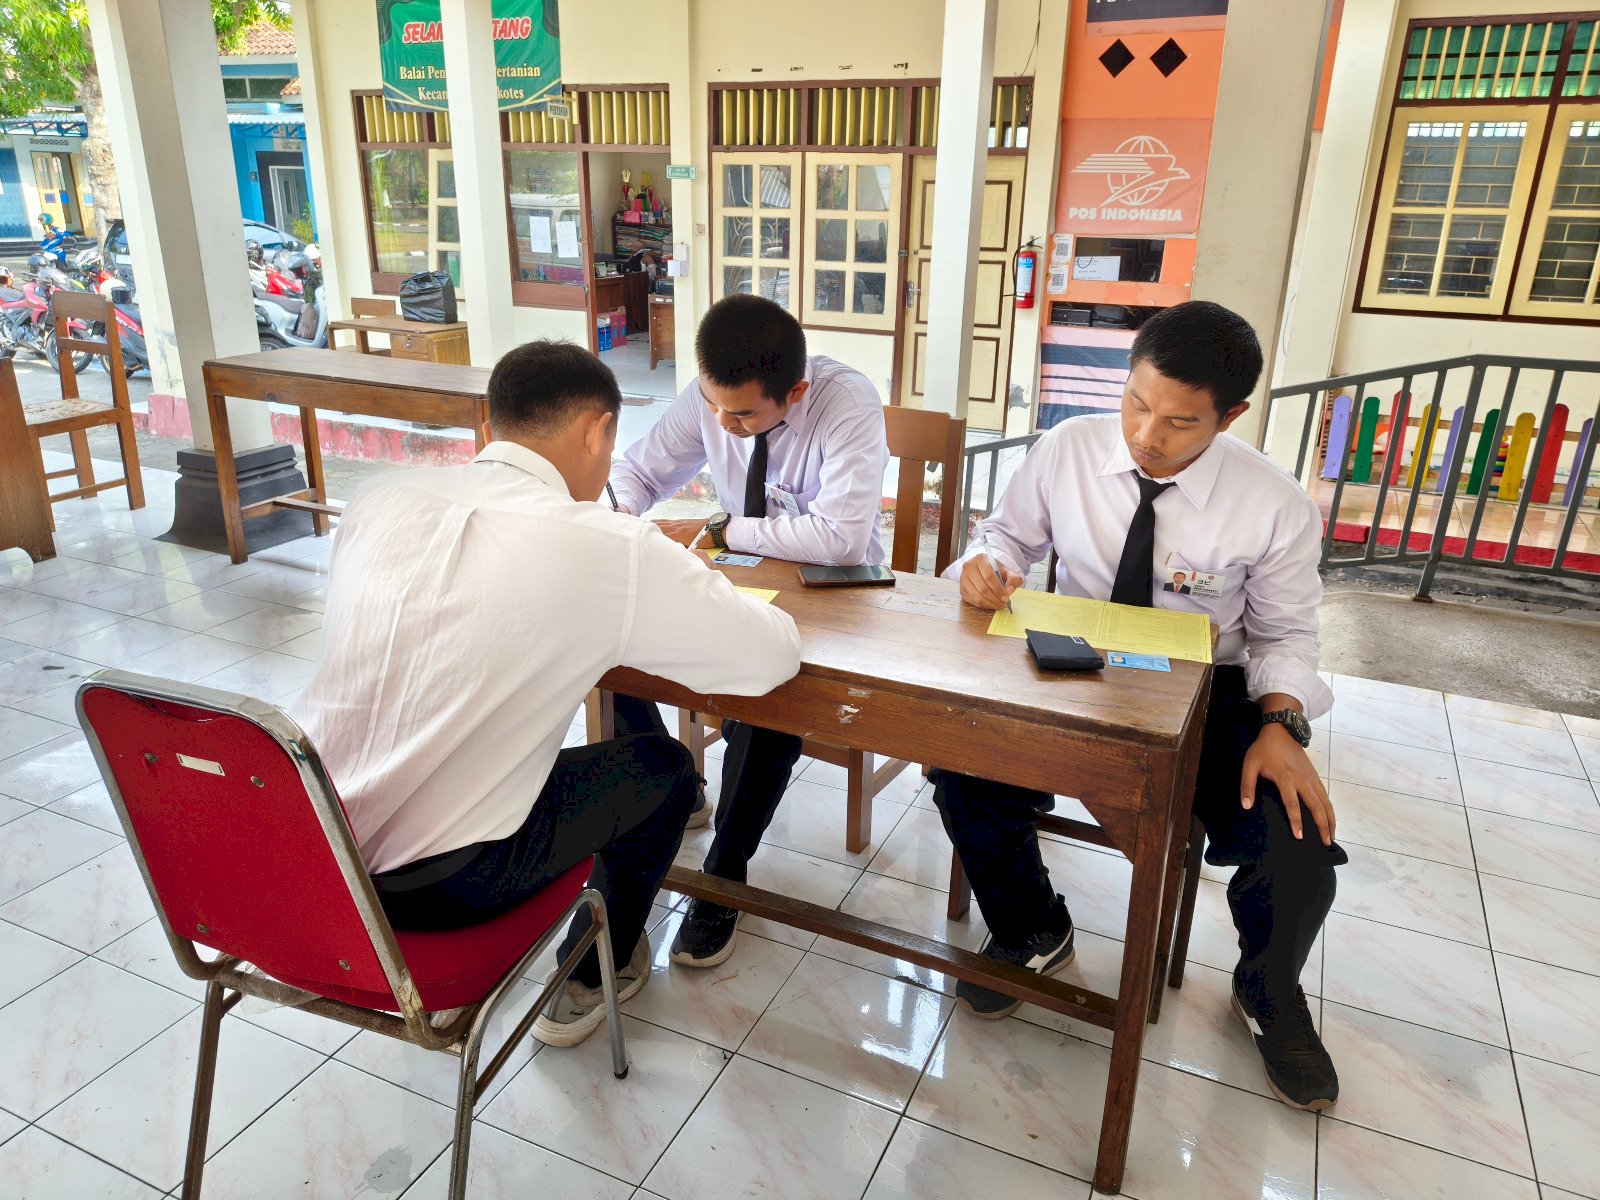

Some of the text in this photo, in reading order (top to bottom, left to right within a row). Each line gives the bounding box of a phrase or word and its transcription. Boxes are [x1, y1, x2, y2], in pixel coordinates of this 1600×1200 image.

[492, 16, 532, 40] TANG
[399, 62, 541, 80] Balai Pen ertanian
[497, 85, 525, 99] kotes
[1069, 207, 1183, 221] POS INDONESIA
